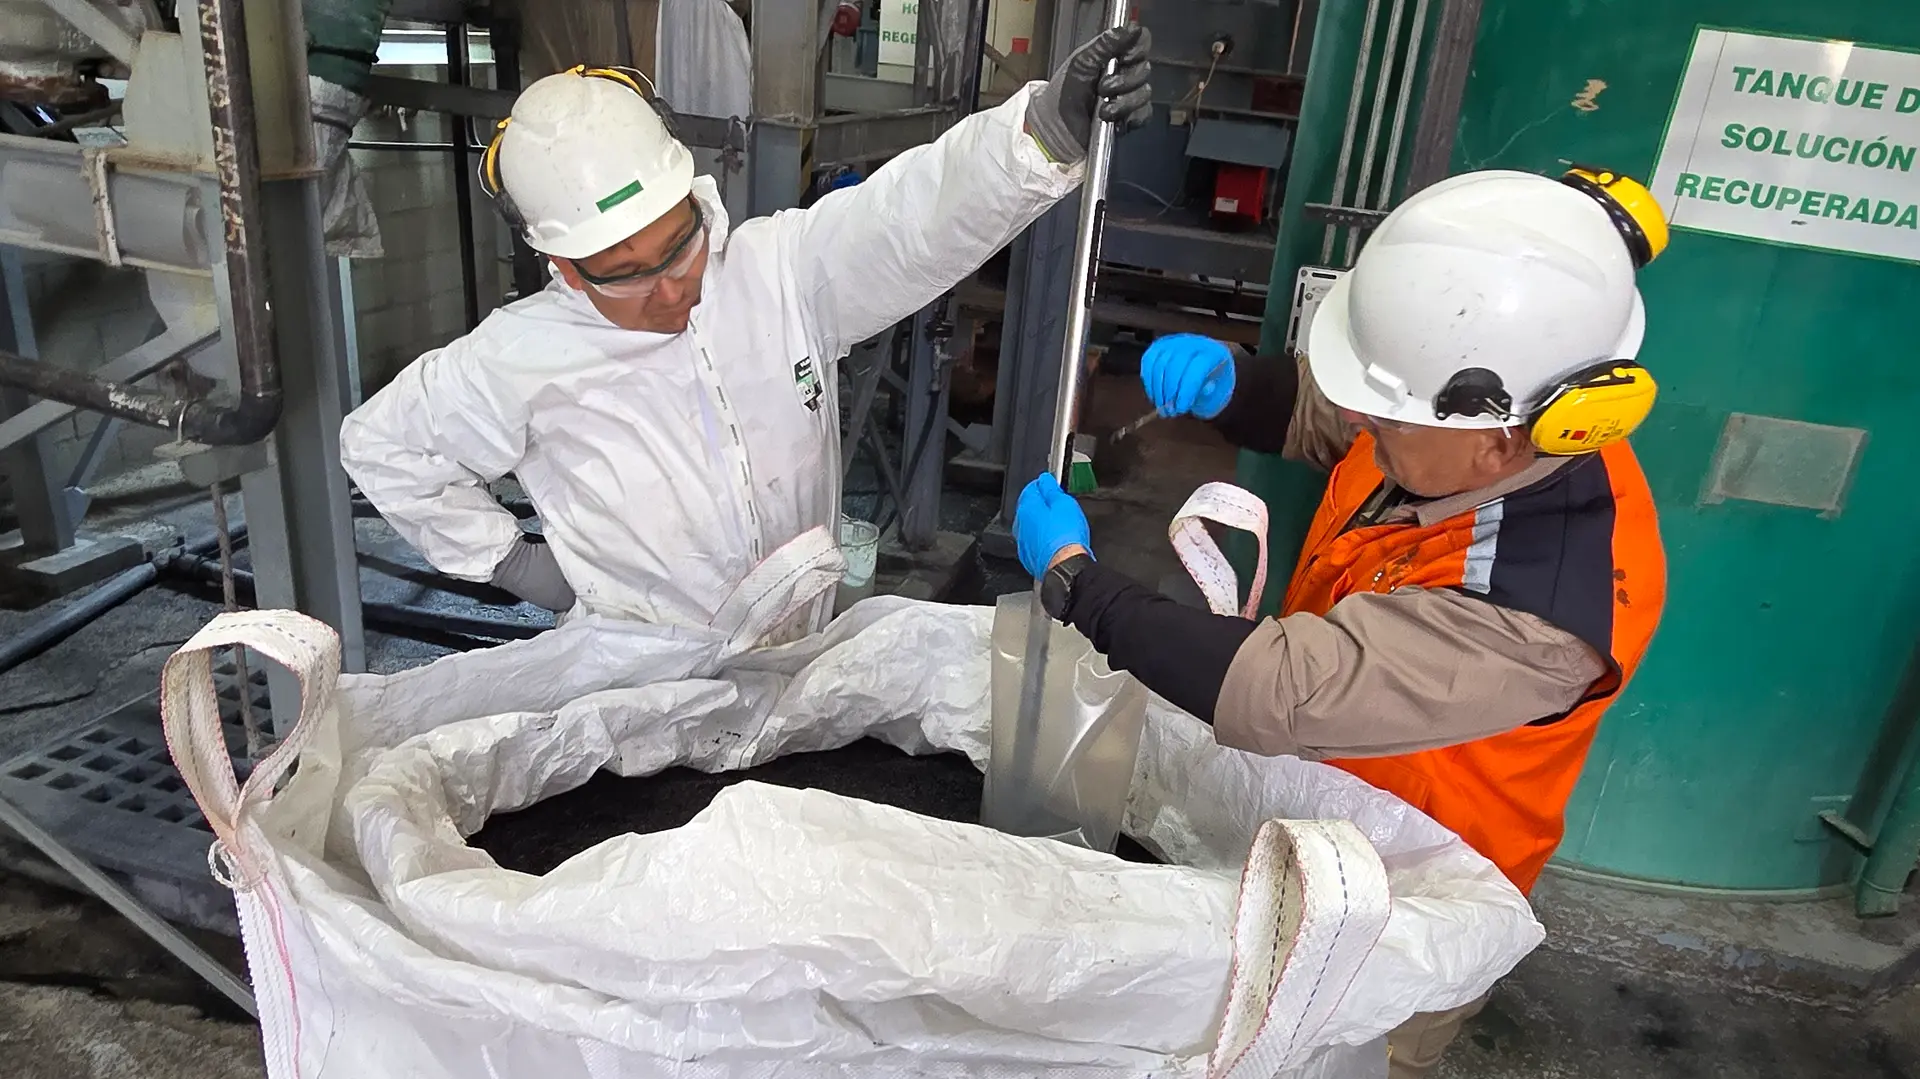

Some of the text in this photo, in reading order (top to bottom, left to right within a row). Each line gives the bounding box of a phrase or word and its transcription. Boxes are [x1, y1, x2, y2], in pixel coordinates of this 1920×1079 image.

[1732, 66, 1920, 114] TANQUE D
[1721, 123, 1917, 172] SOLUCIÓN
[1674, 172, 1918, 230] RECUPERADA
